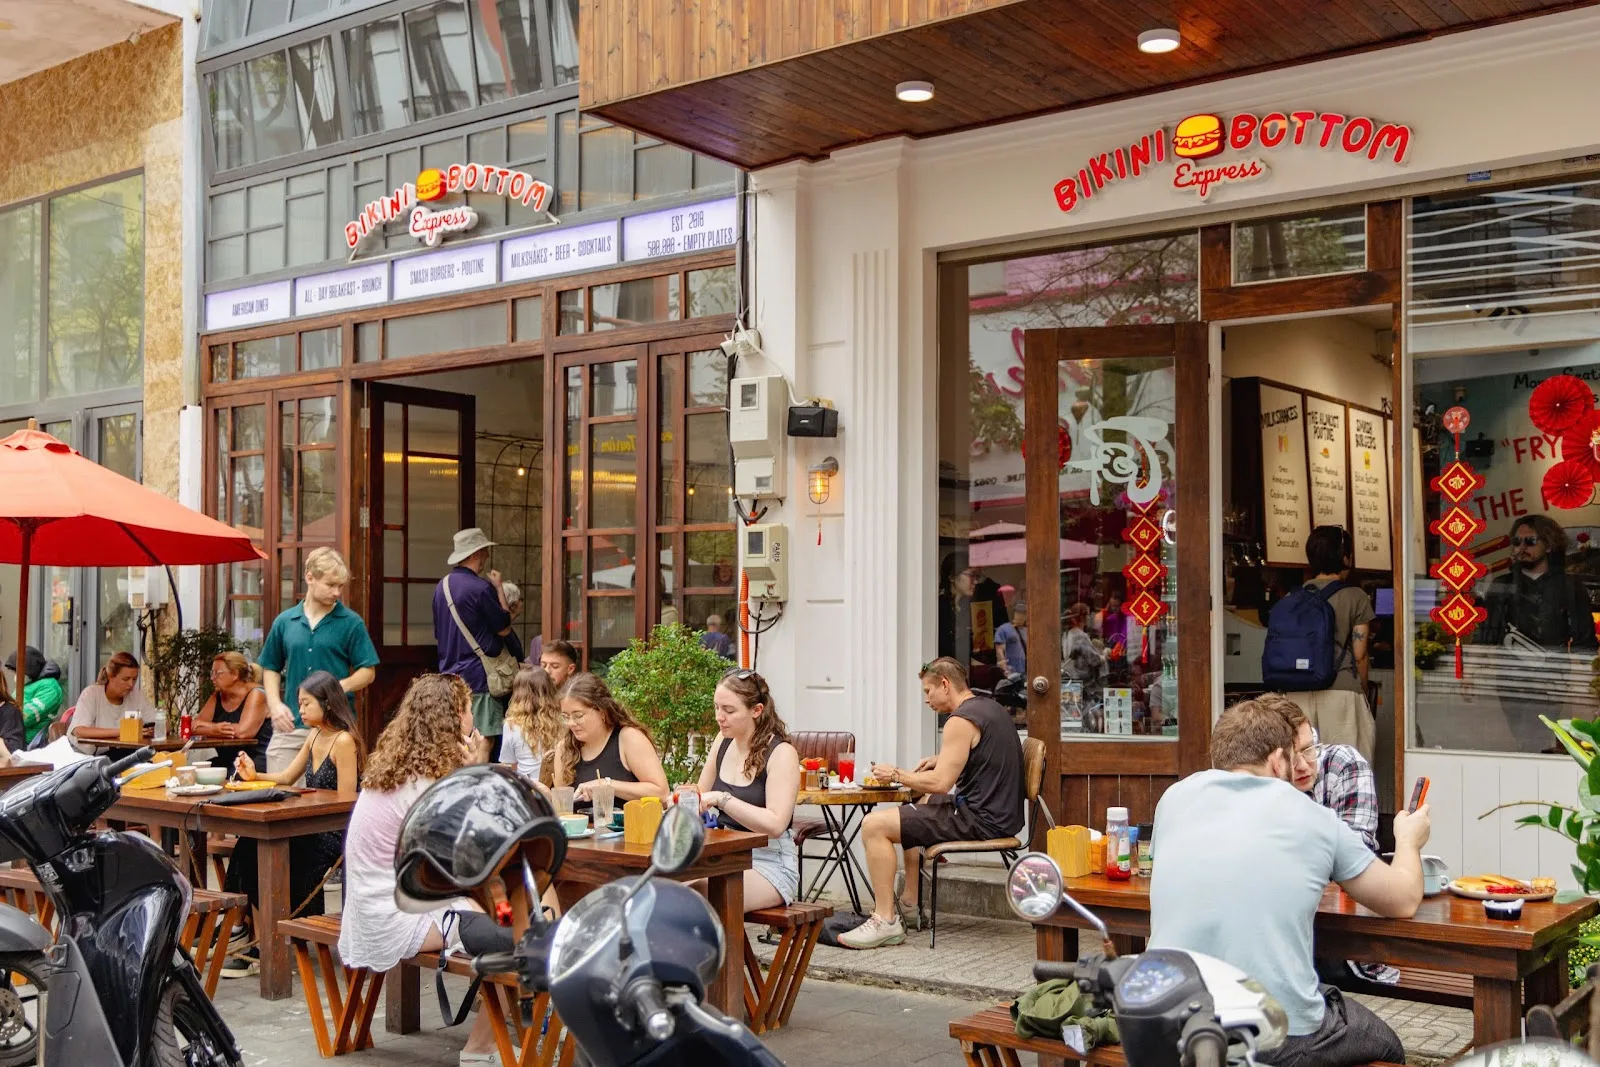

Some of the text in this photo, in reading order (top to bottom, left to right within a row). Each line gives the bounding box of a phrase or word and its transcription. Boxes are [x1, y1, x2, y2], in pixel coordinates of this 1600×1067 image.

[1053, 111, 1412, 213] BIKINI BOTTOM
[1174, 160, 1263, 197] Express
[344, 163, 549, 248] BIKINI BOTTOM
[412, 210, 468, 241] Express
[671, 214, 684, 232] EST
[510, 235, 612, 268] MILKSHAKES BEER COCKTAILS
[683, 232, 706, 251] EMPTY
[707, 227, 733, 248] PLATES
[409, 258, 484, 285] SMASH BURGERS POUTINE
[305, 276, 382, 303] ALL DAY BREAKFAST BRUNCH
[232, 298, 269, 317] AMERICAN DINER
[1260, 405, 1298, 429] MILKSHAKES
[1474, 488, 1528, 521] THE
